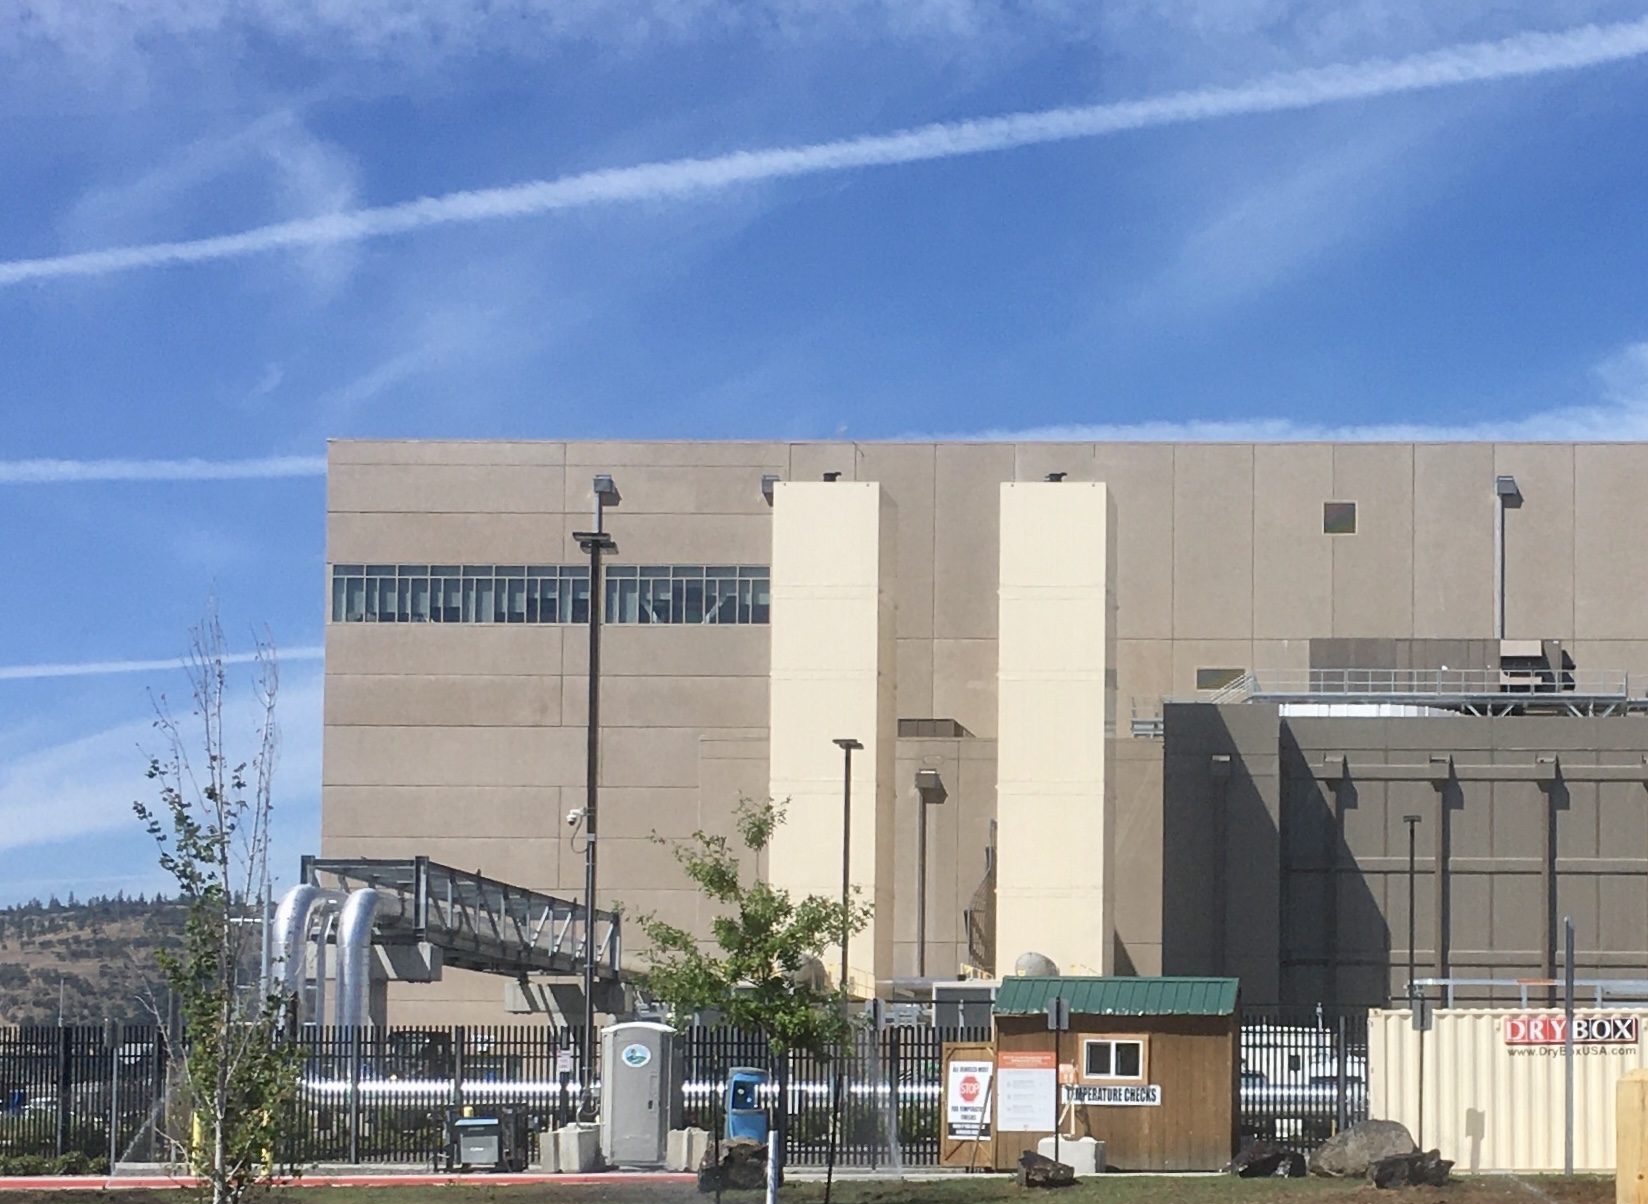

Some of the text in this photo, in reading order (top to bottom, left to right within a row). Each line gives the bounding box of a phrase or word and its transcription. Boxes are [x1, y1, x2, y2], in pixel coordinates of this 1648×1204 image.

[1507, 1046, 1637, 1058] www.DryBxUSA.com
[961, 1082, 979, 1095] STOP
[1065, 1086, 1157, 1103] TMPERATURE CHECKS
